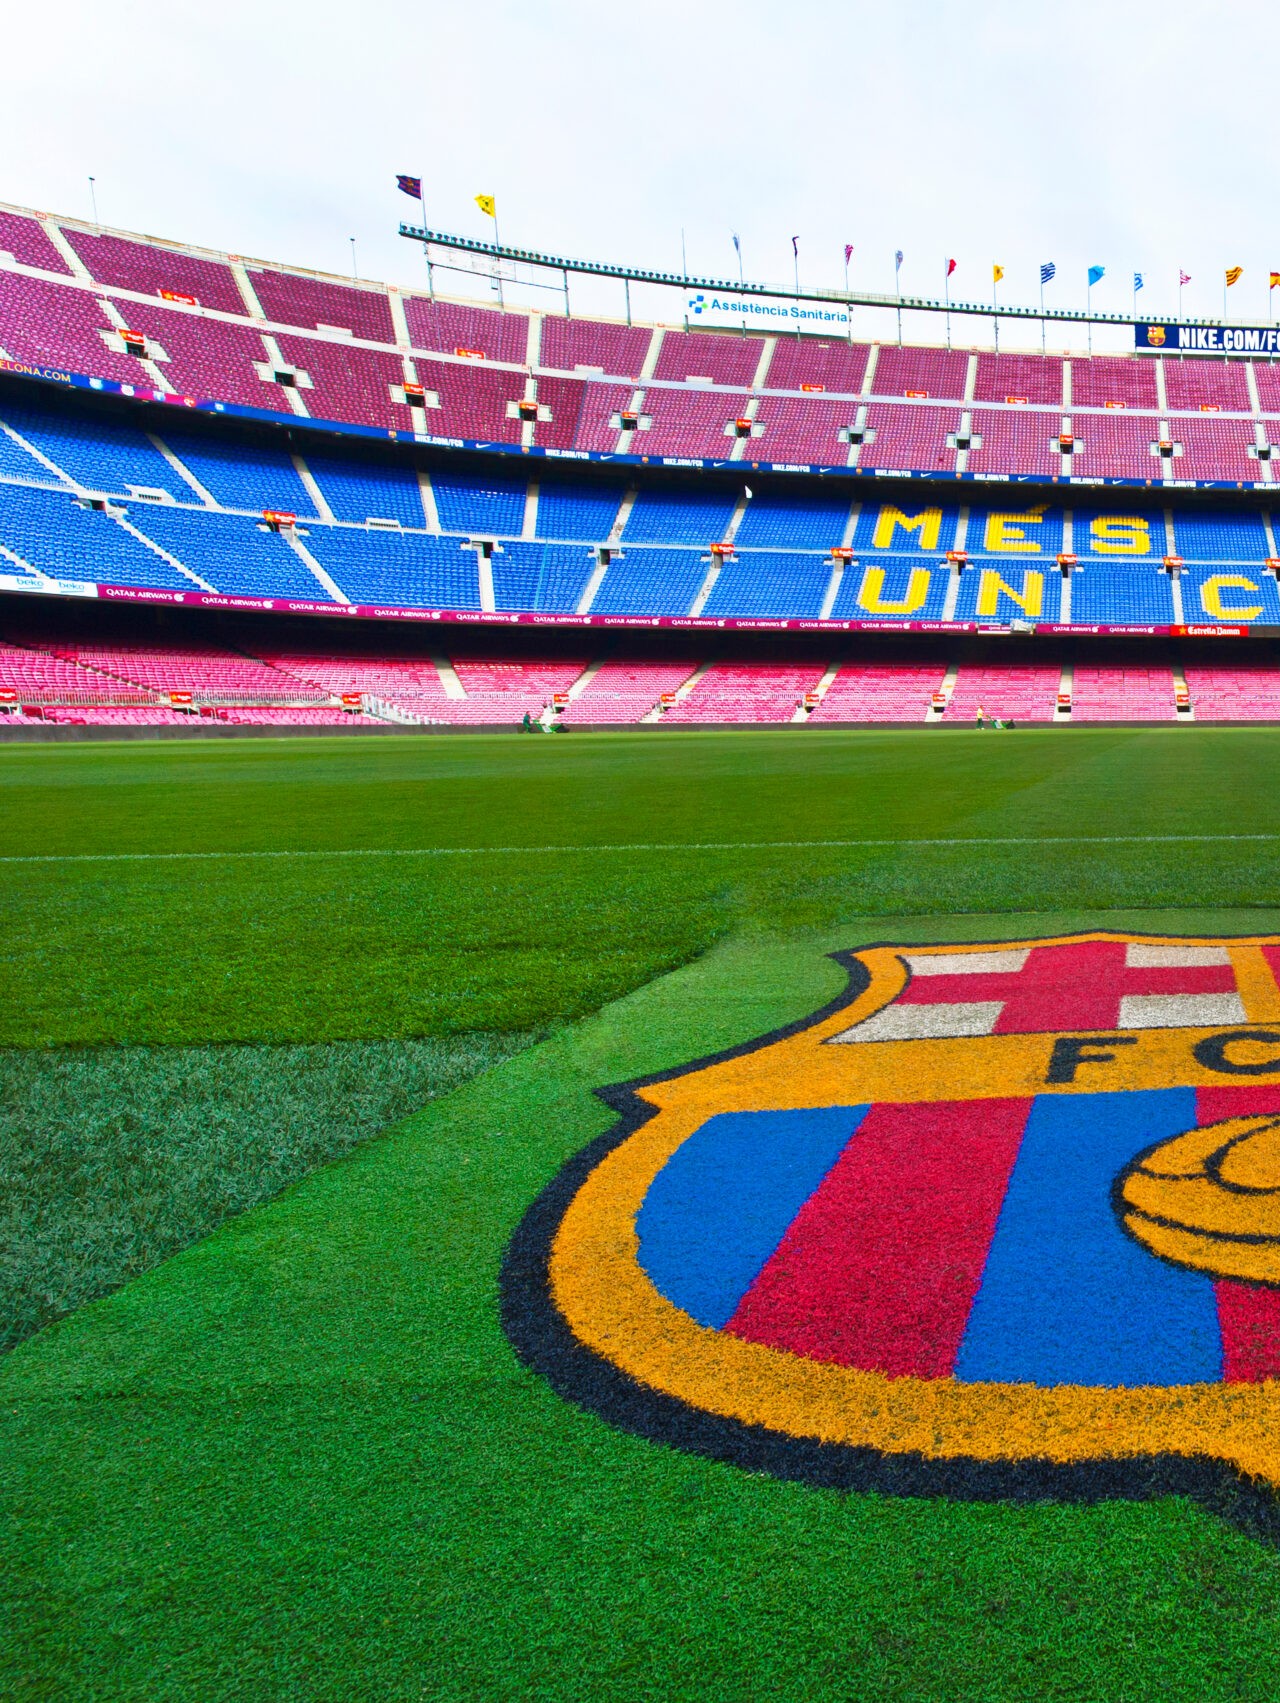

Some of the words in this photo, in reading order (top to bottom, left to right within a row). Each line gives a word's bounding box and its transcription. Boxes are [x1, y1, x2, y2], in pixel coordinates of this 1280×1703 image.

[712, 299, 788, 316] Assistència
[791, 307, 848, 322] Sanitària
[873, 504, 1150, 554] MÉS
[16, 577, 44, 586] beko
[58, 582, 85, 591] beko
[106, 589, 135, 598] QATAR
[138, 592, 172, 600] AIRWAYS
[857, 566, 1043, 617] UN
[202, 597, 228, 605] QATAR
[230, 600, 262, 608] AIRWAYS
[401, 611, 430, 619] AIRWAYS
[1216, 626, 1240, 635] Damm
